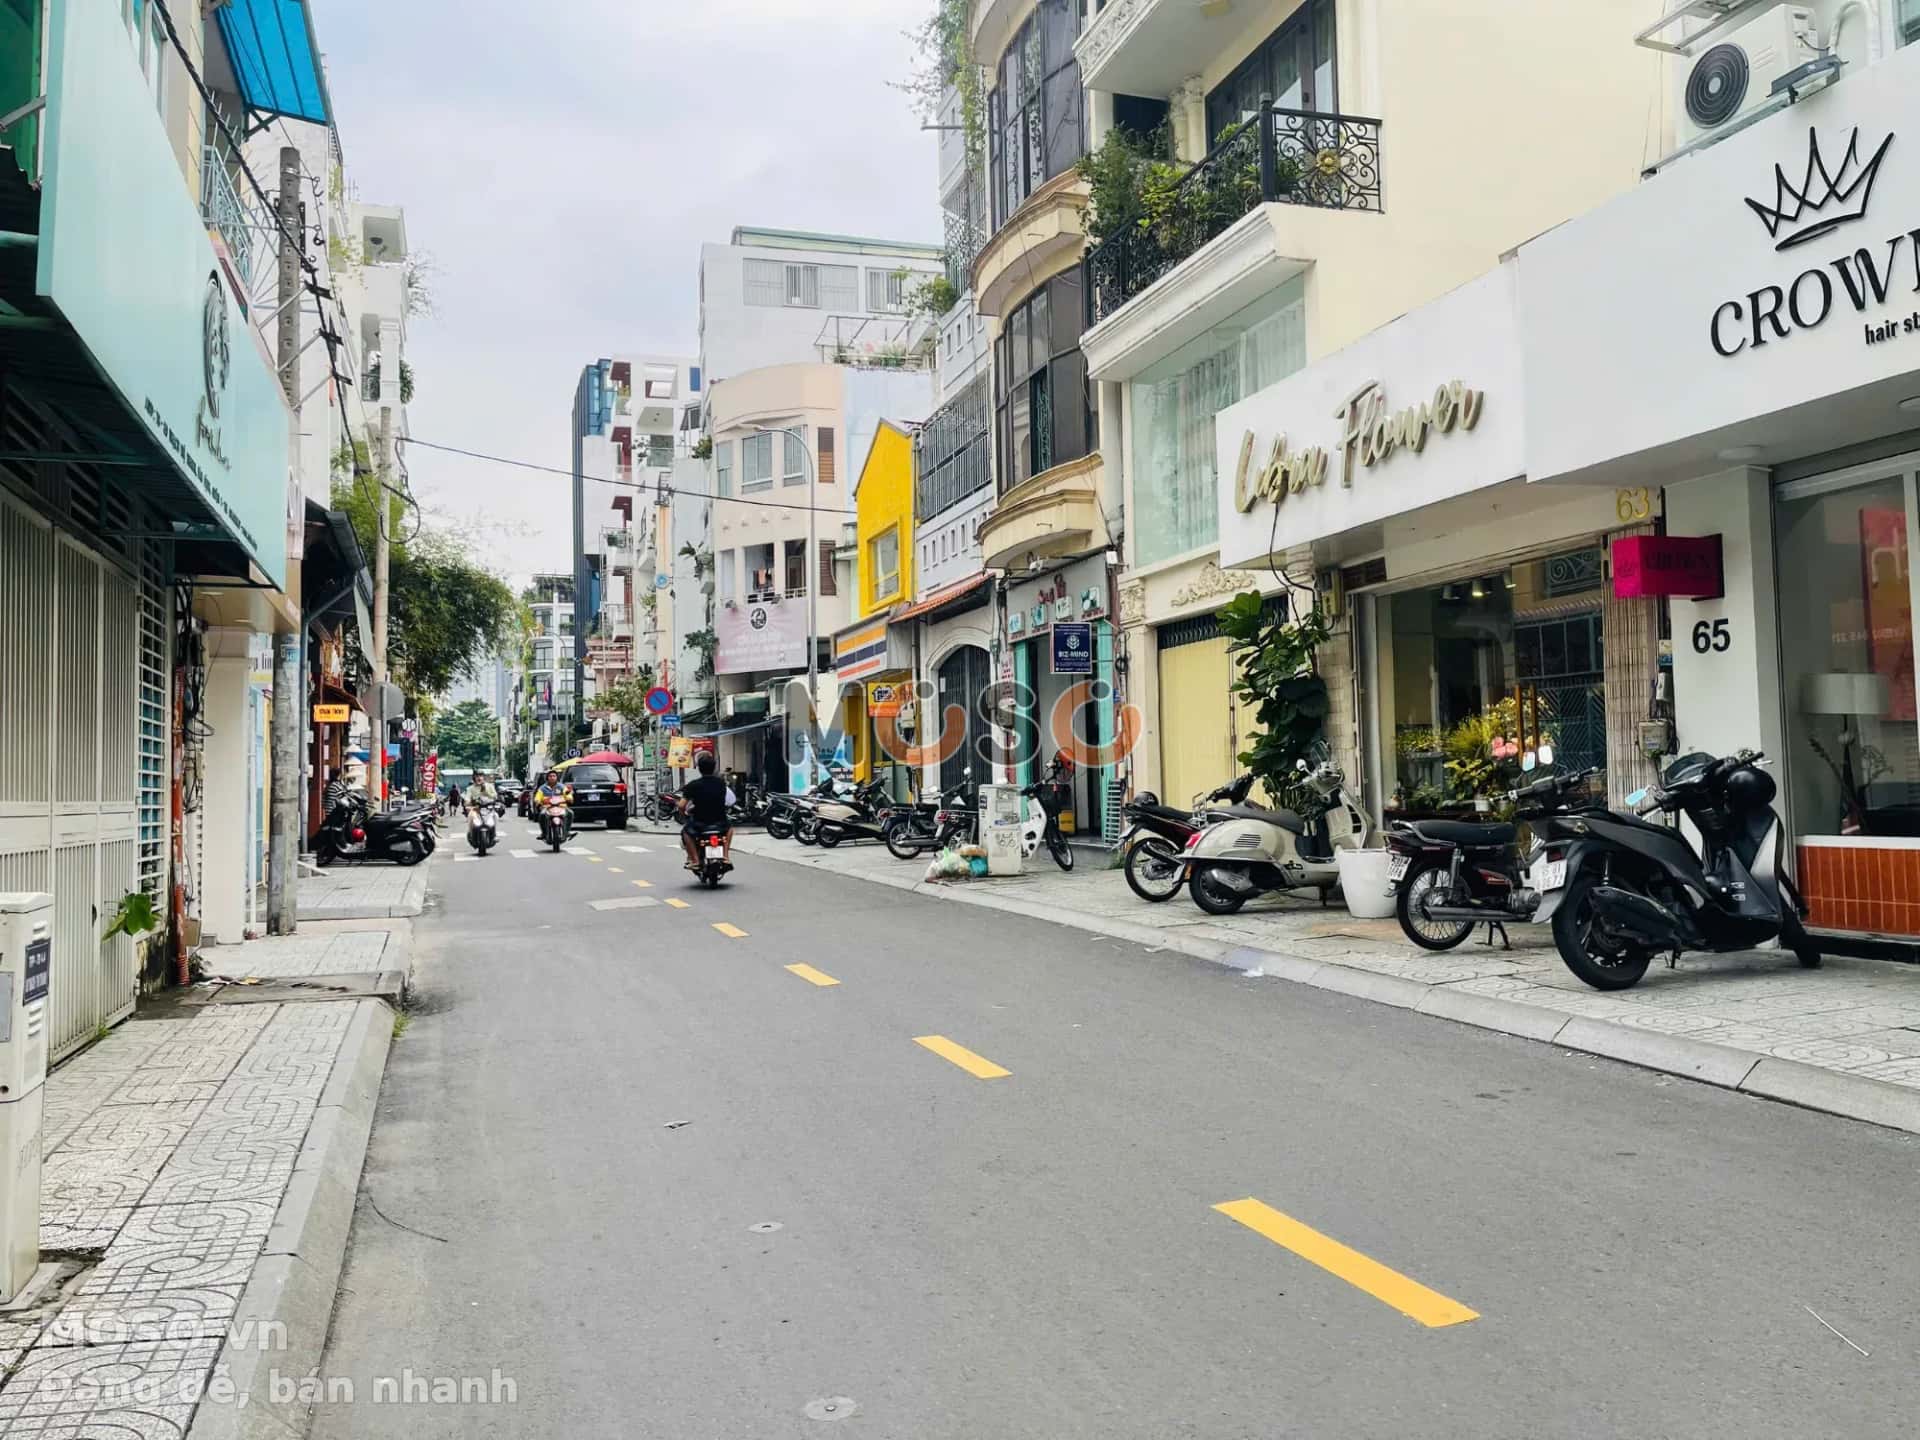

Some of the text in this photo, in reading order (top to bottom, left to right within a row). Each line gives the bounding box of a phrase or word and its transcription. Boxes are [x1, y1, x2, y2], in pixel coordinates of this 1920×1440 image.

[1864, 319, 1898, 345] hair
[1235, 378, 1485, 513] Libra Flower
[1616, 486, 1650, 522] 63
[1692, 618, 1731, 654] 65
